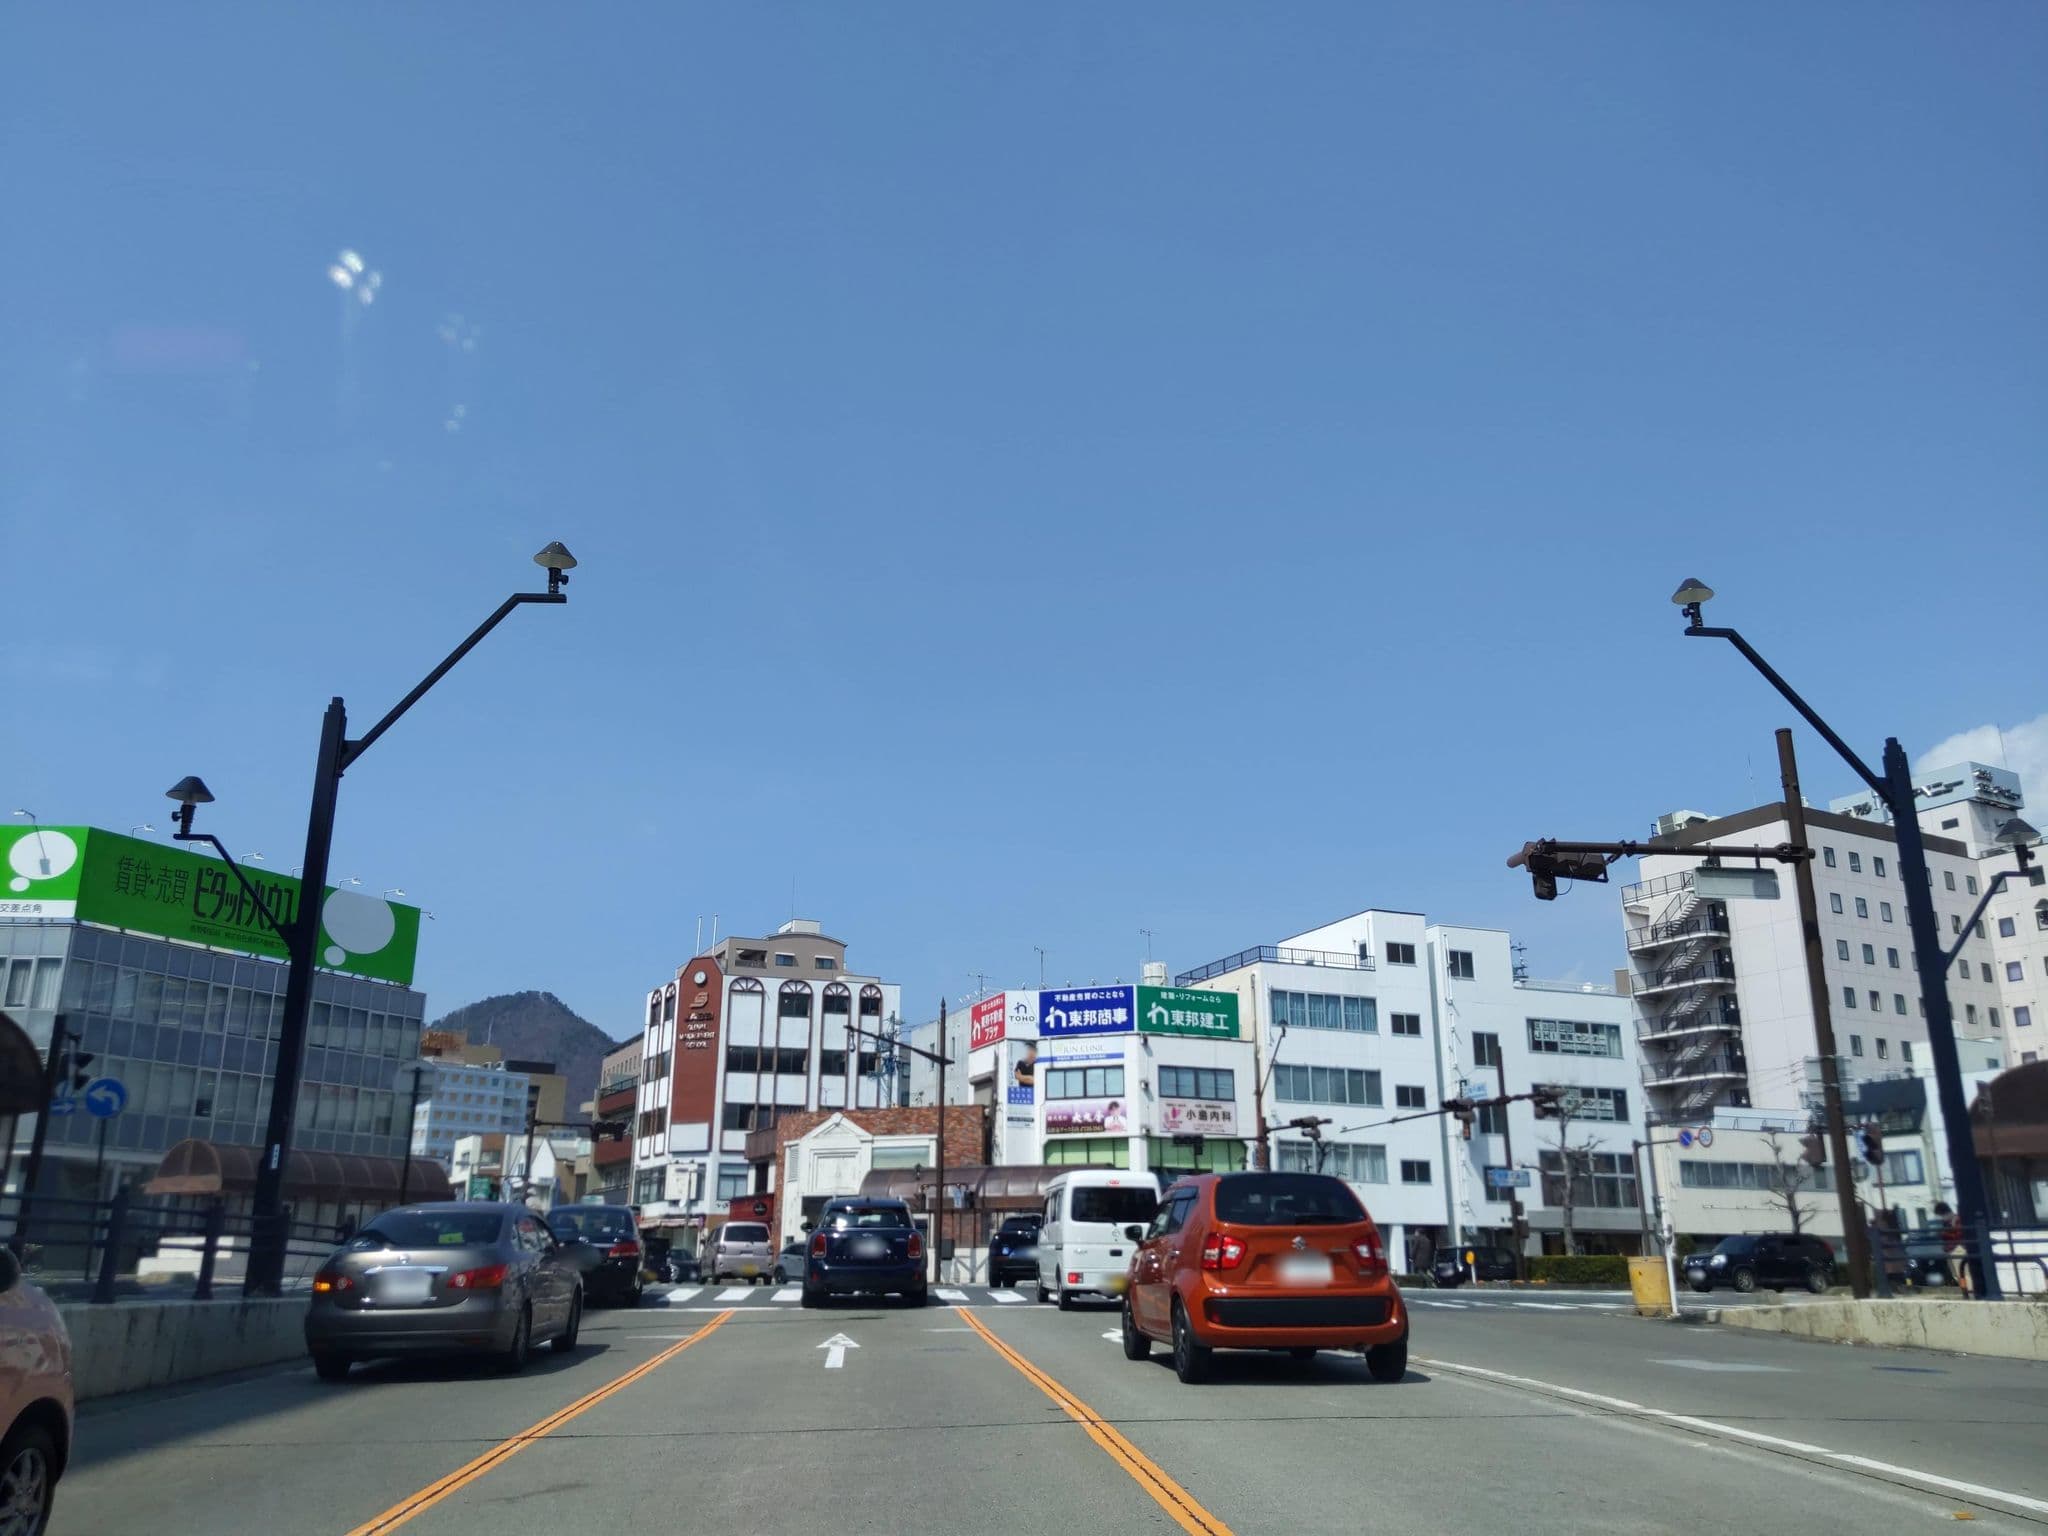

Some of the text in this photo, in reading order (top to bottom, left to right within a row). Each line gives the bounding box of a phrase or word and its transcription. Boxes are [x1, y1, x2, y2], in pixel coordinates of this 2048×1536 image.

[1069, 1007, 1128, 1026] 東邦商事
[1170, 1009, 1230, 1030] 東邦建工
